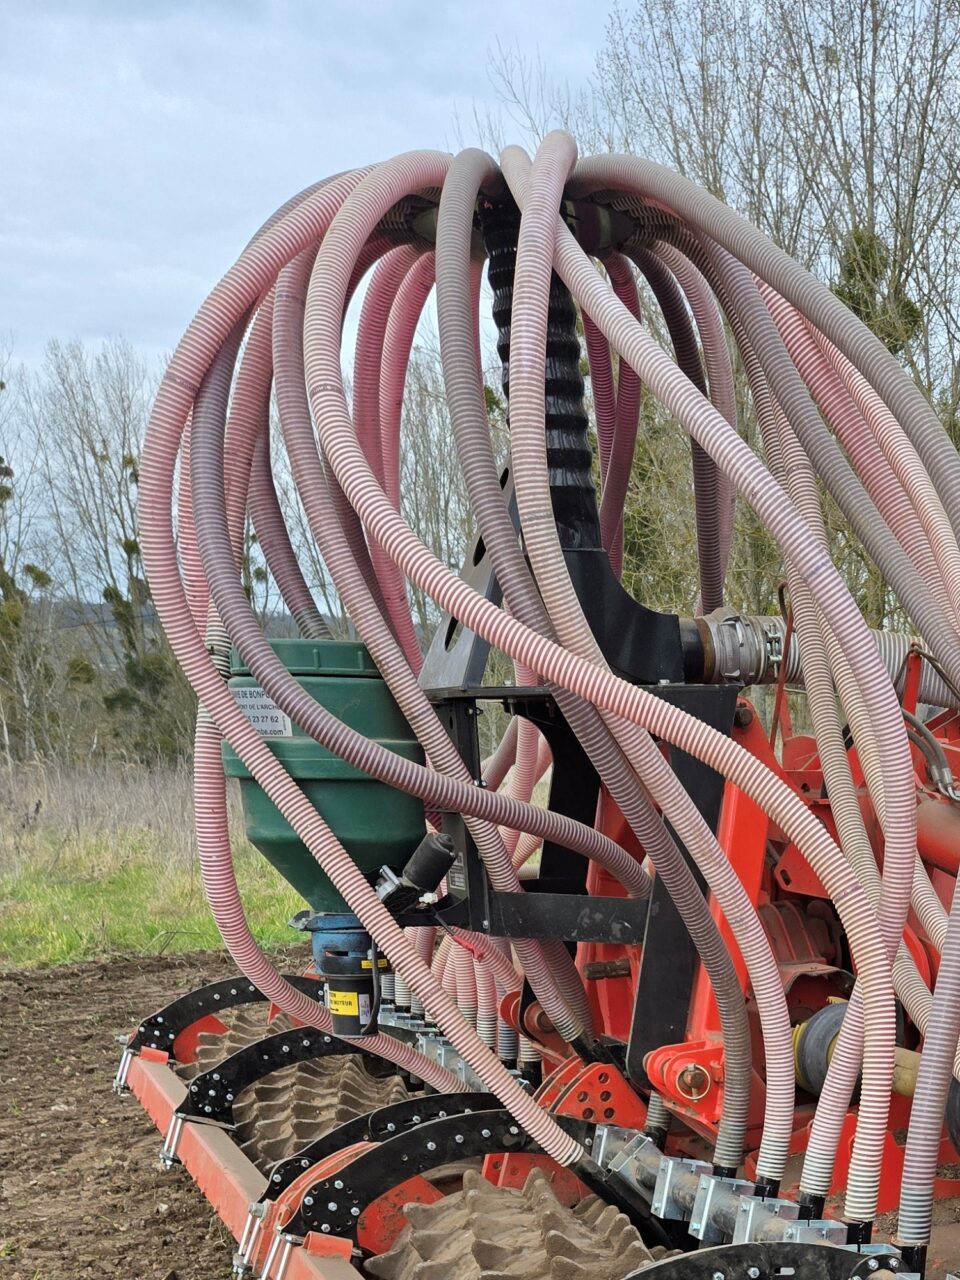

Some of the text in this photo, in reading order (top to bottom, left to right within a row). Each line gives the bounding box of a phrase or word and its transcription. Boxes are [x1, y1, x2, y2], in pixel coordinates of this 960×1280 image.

[249, 690, 271, 699] BONPO
[252, 715, 260, 723] 23
[260, 715, 268, 723] 27
[270, 715, 279, 723] 62
